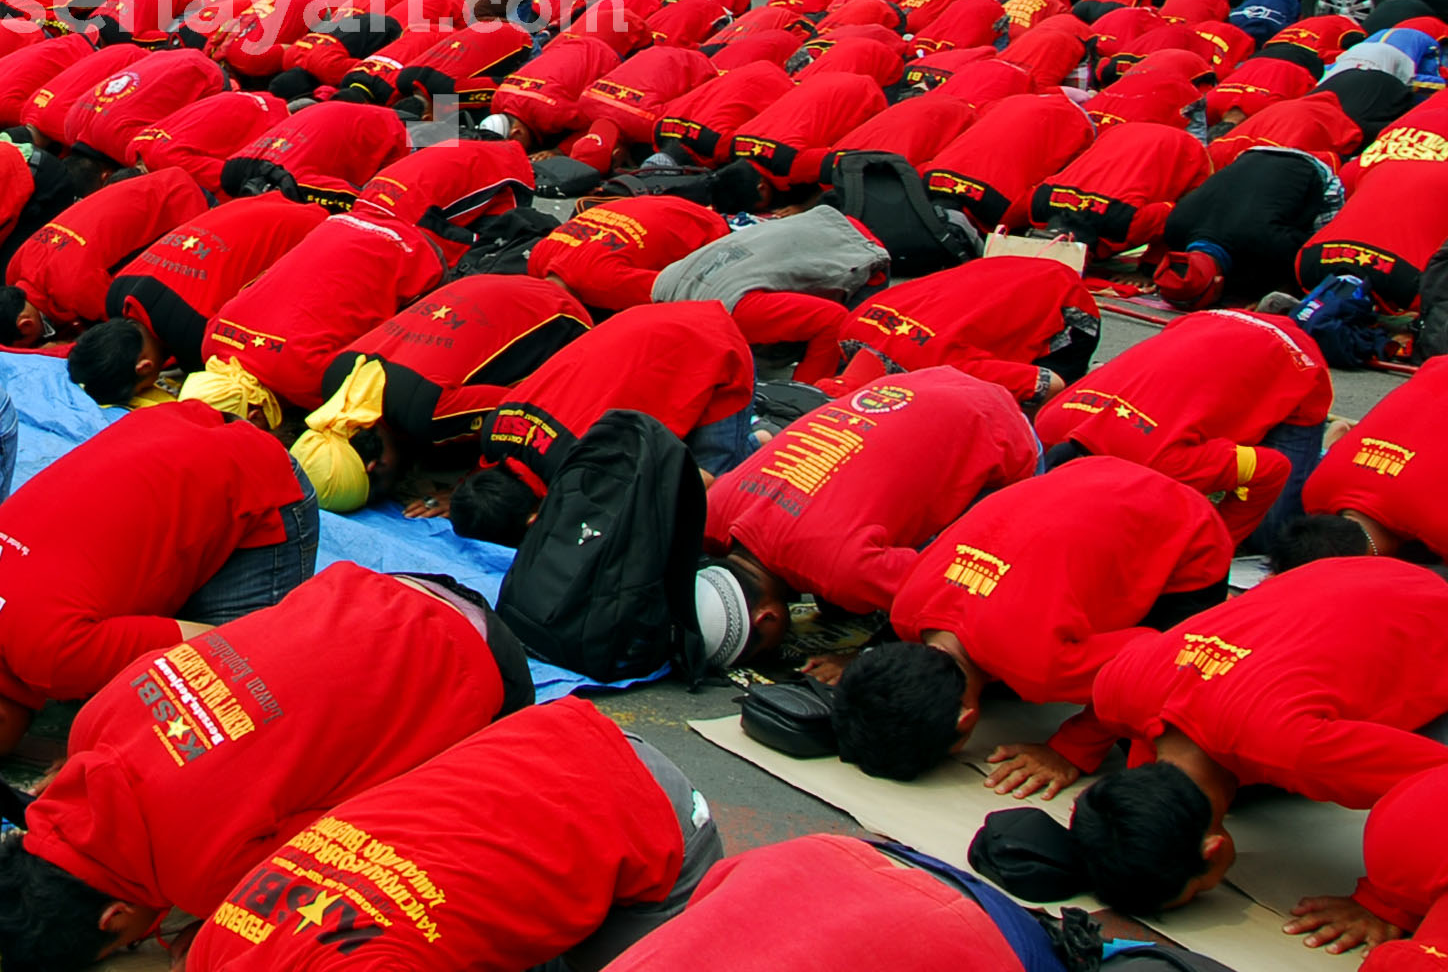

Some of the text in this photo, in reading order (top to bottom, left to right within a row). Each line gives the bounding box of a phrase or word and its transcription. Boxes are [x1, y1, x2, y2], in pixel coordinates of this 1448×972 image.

[211, 695, 256, 741] REBUT
[246, 677, 284, 725] Lawan
[345, 888, 392, 927] KONGRES
